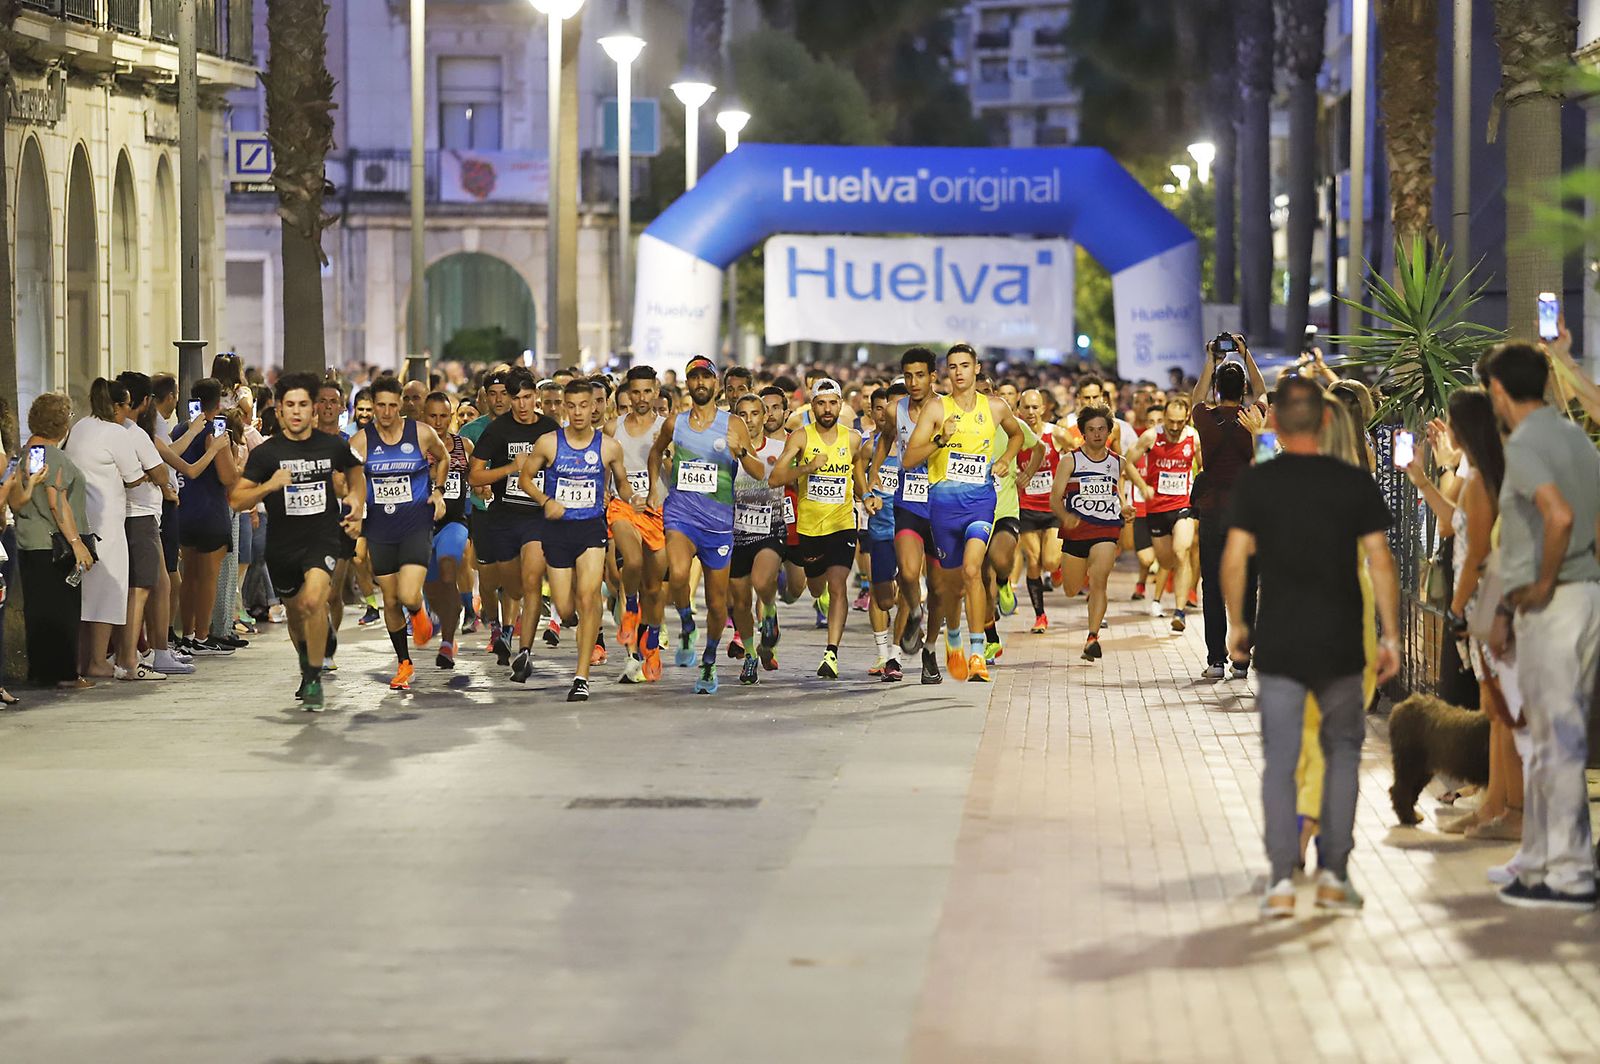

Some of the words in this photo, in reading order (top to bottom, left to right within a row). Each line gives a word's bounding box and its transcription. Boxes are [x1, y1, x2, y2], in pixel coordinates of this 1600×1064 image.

[783, 168, 917, 203] Huelva
[929, 168, 1059, 211] original
[787, 247, 1030, 306] Huelva
[647, 303, 704, 317] Huelva
[1131, 306, 1188, 321] Huelva
[509, 445, 523, 454] RUN
[282, 462, 299, 471] RUN
[301, 461, 316, 471] FOR
[317, 459, 331, 469] FUN
[957, 463, 976, 475] 249
[687, 472, 706, 483] 646
[882, 475, 898, 488] 739
[383, 486, 401, 497] 548
[817, 486, 835, 497] 655
[1089, 484, 1105, 494] 303
[297, 495, 316, 507] 198
[569, 490, 582, 501] 13
[1073, 496, 1116, 515] CODA
[743, 513, 760, 526] 111
